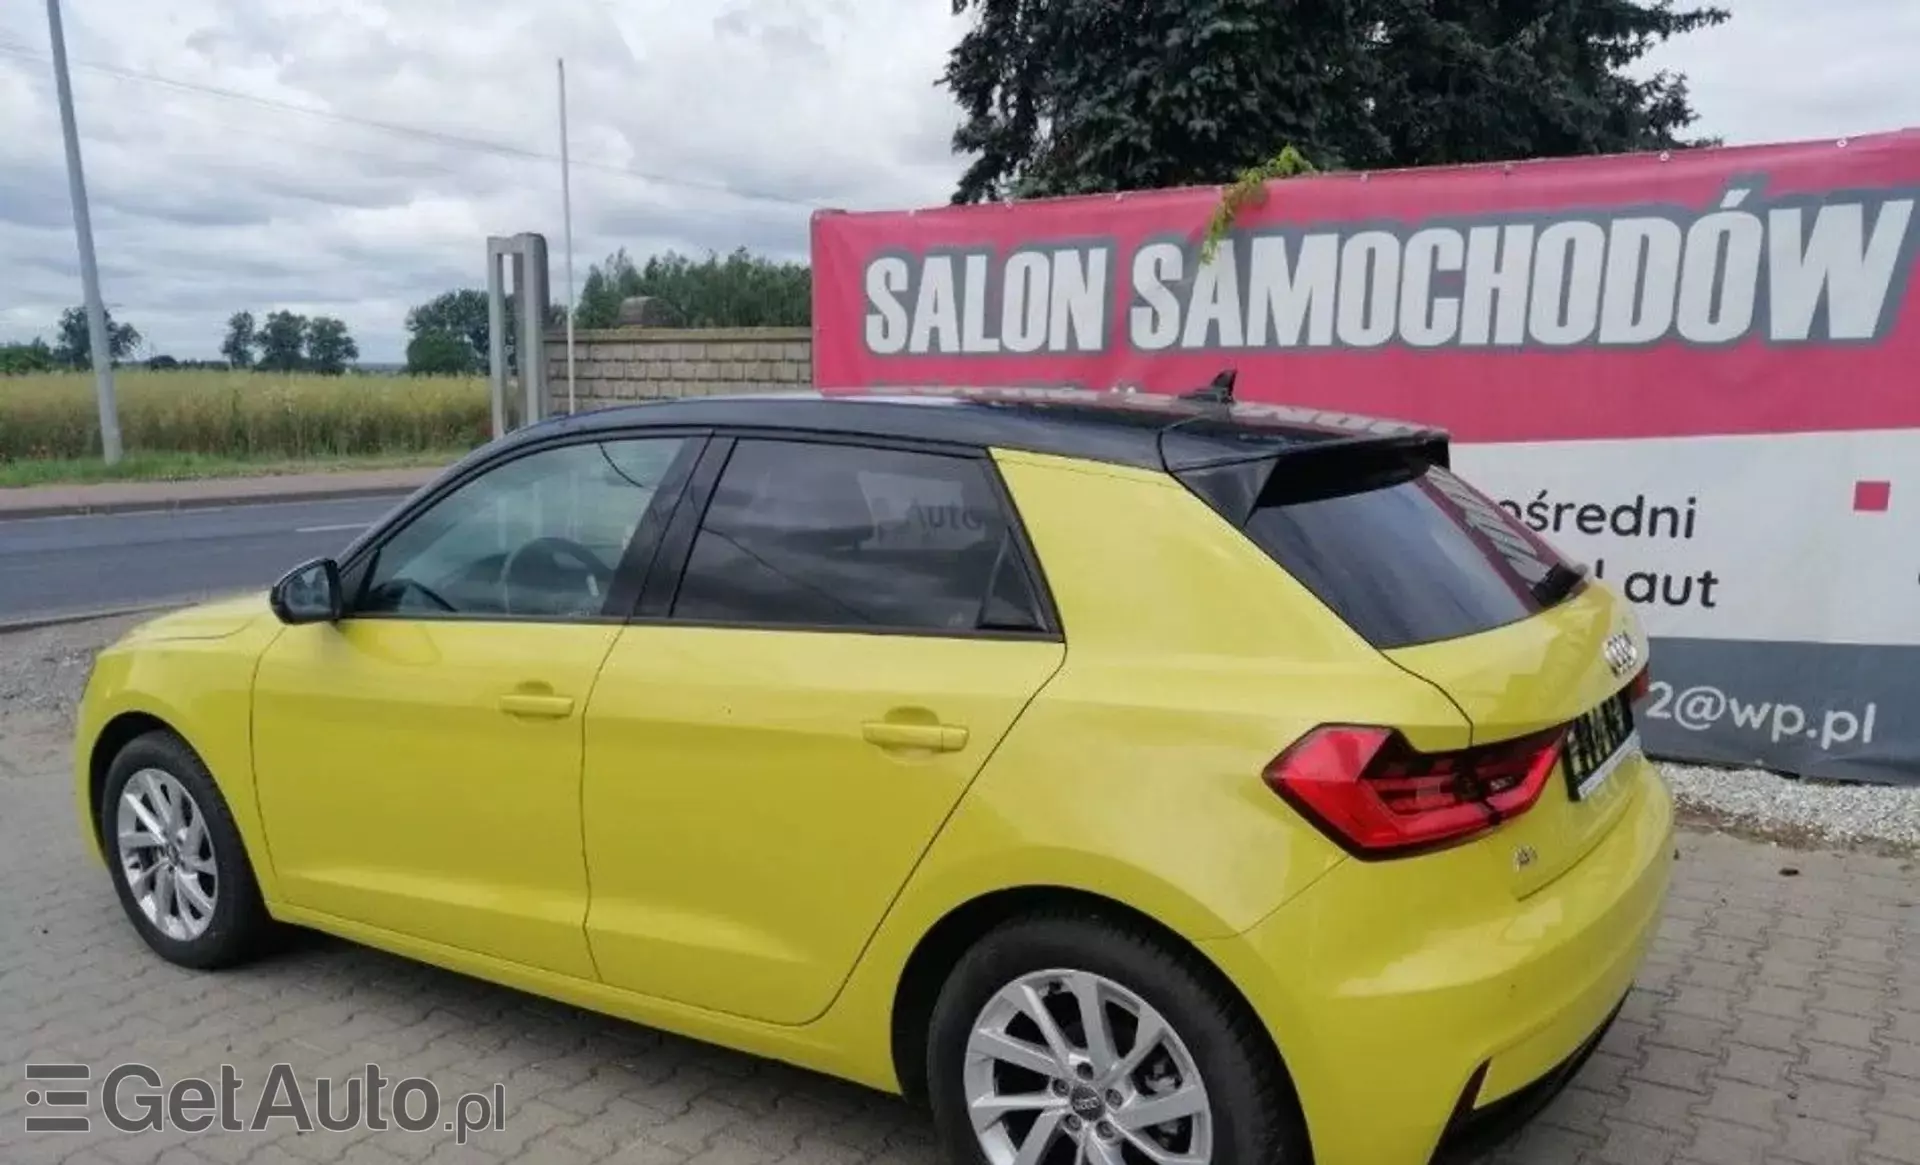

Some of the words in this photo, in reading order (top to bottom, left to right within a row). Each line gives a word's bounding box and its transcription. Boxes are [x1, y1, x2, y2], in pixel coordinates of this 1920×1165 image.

[865, 247, 1108, 354] SALON
[1130, 188, 1914, 349] SAMOCHODÓW
[1624, 570, 1718, 608] aut
[1646, 681, 1876, 750] 2@wp.pl
